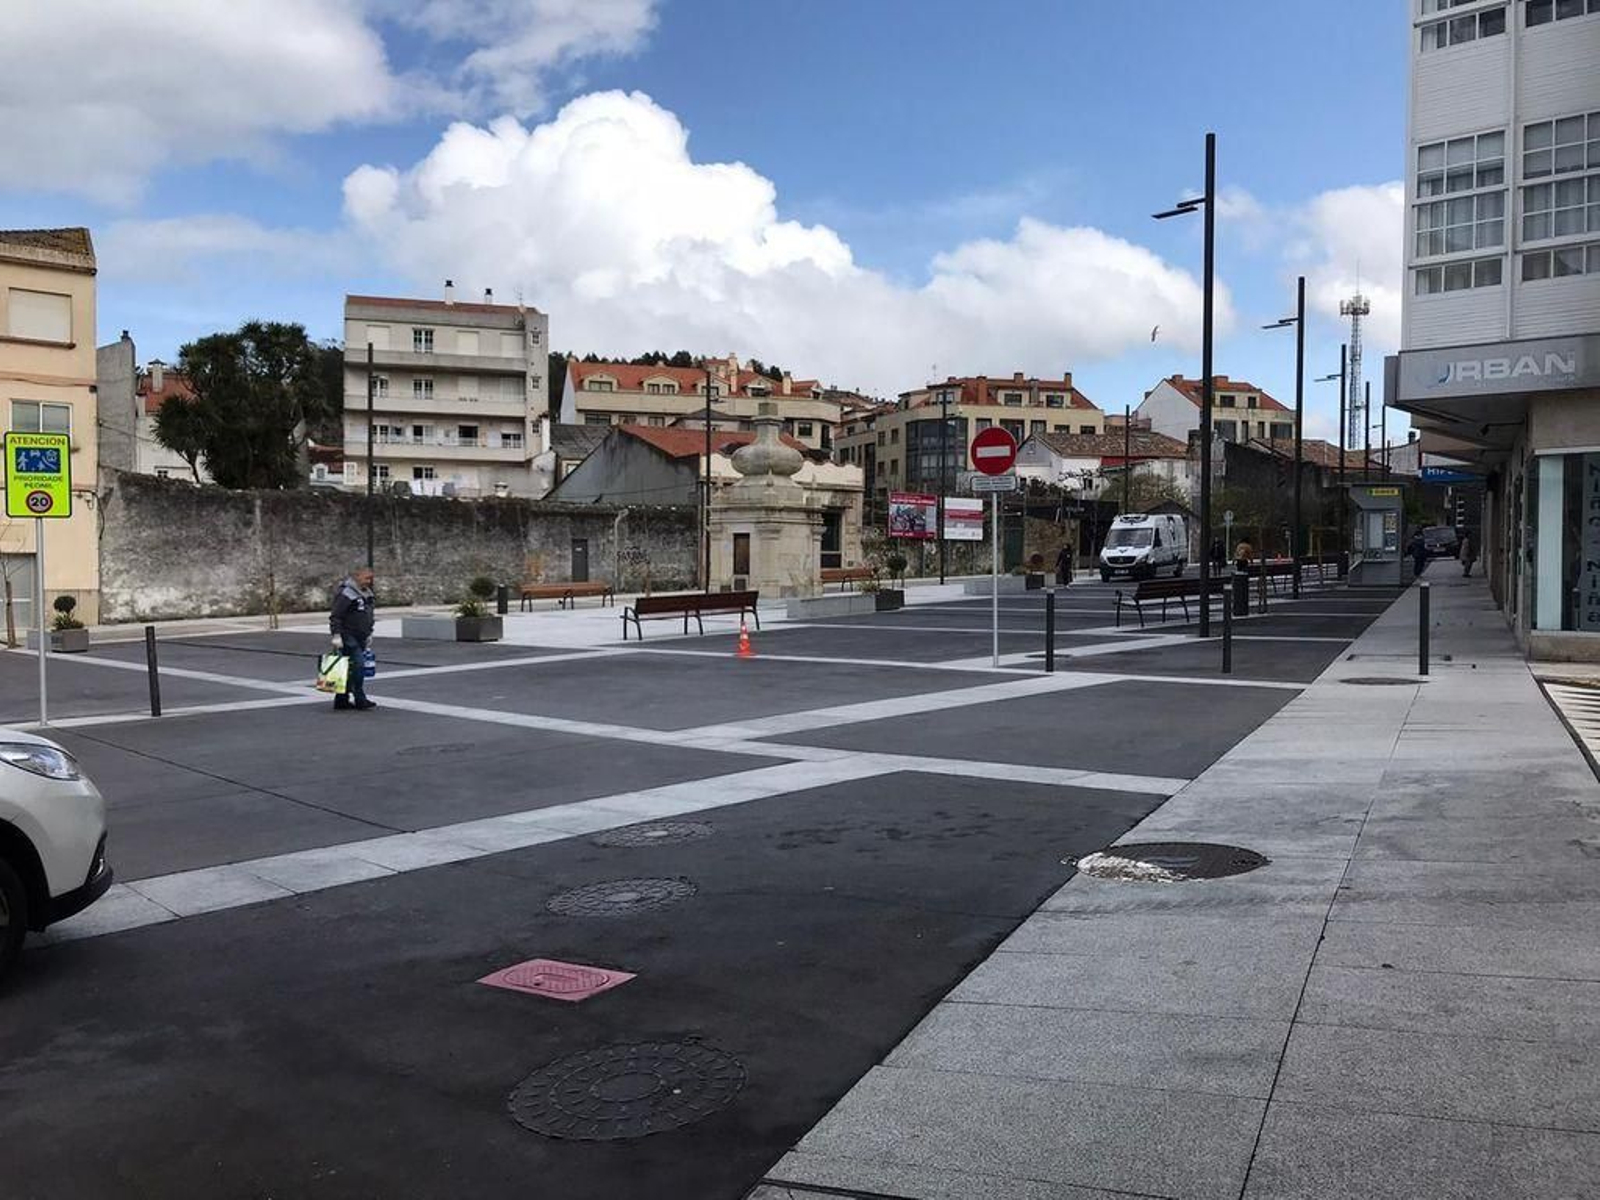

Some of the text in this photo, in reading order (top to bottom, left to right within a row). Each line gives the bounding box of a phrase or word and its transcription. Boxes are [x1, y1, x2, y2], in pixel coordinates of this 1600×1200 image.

[1430, 352, 1575, 386] URBAN
[10, 436, 66, 446] ATENCION
[30, 497, 49, 507] 20
